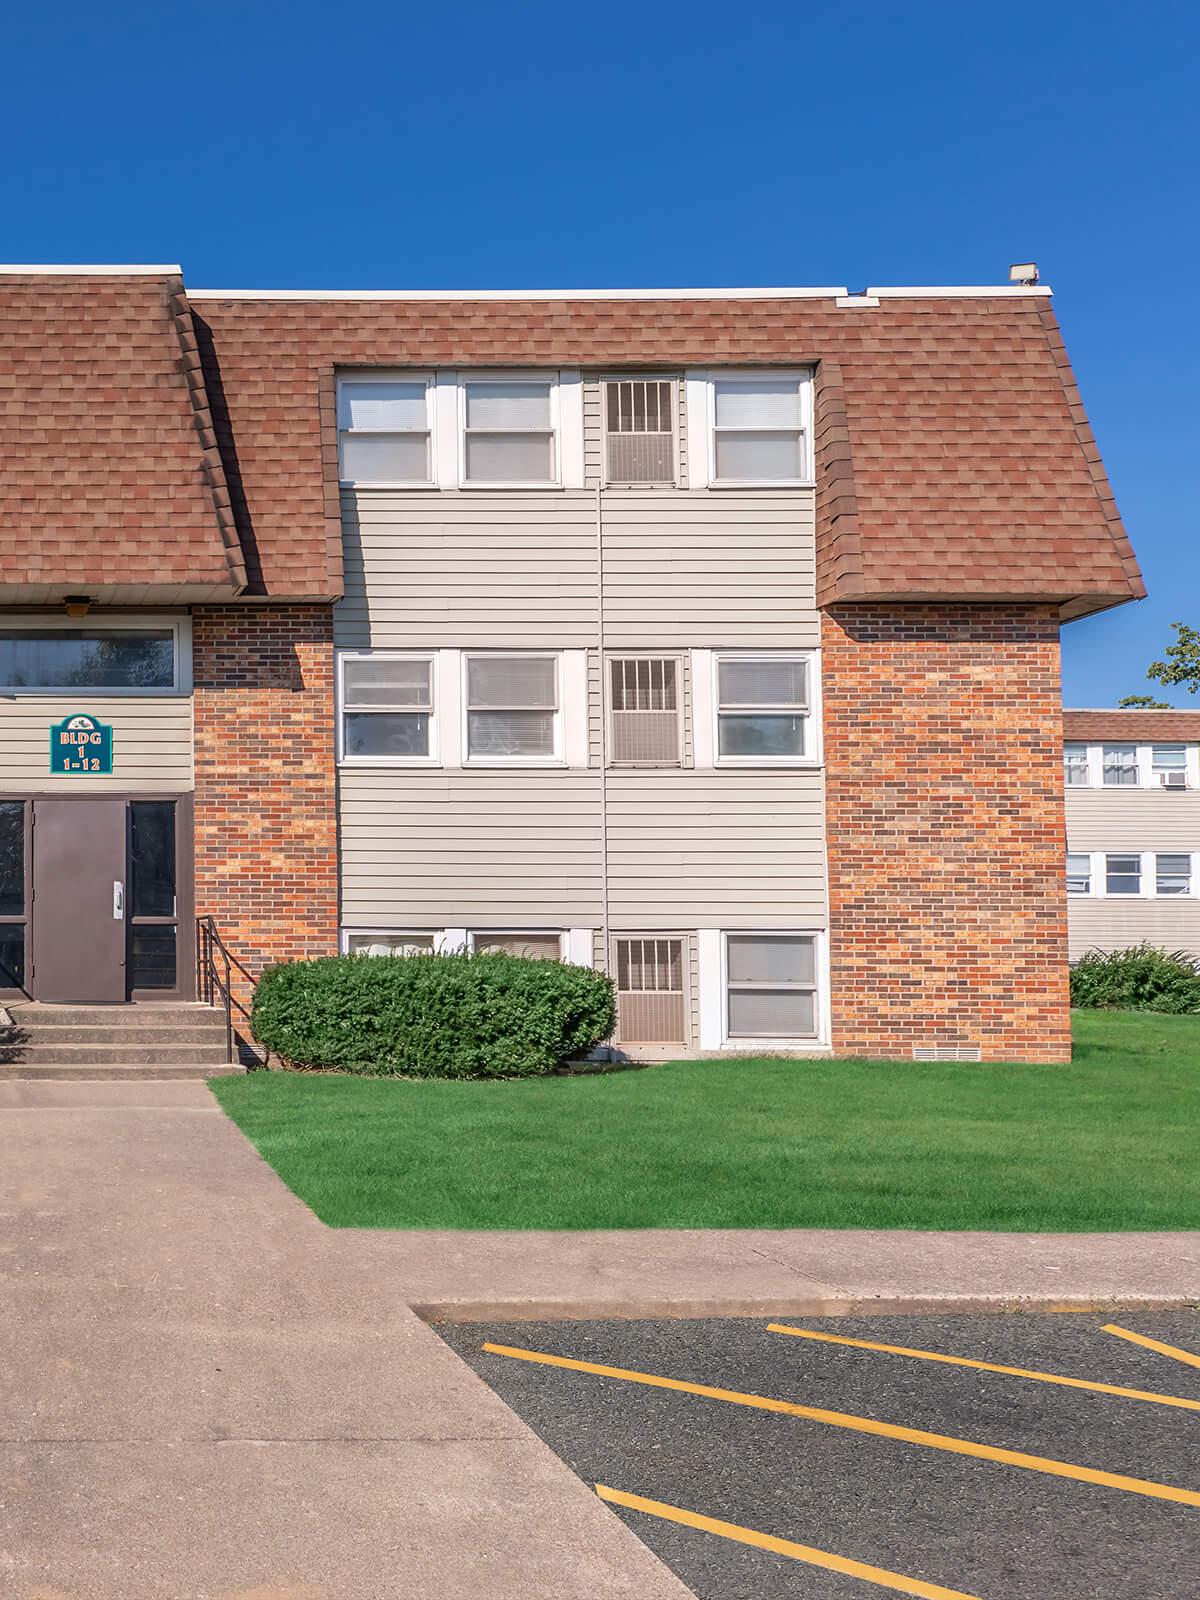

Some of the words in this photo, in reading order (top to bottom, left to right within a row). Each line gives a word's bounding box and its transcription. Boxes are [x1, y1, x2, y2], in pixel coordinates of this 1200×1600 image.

[60, 732, 101, 745] BLDG
[78, 745, 85, 758] 1
[63, 757, 100, 770] 1-12
